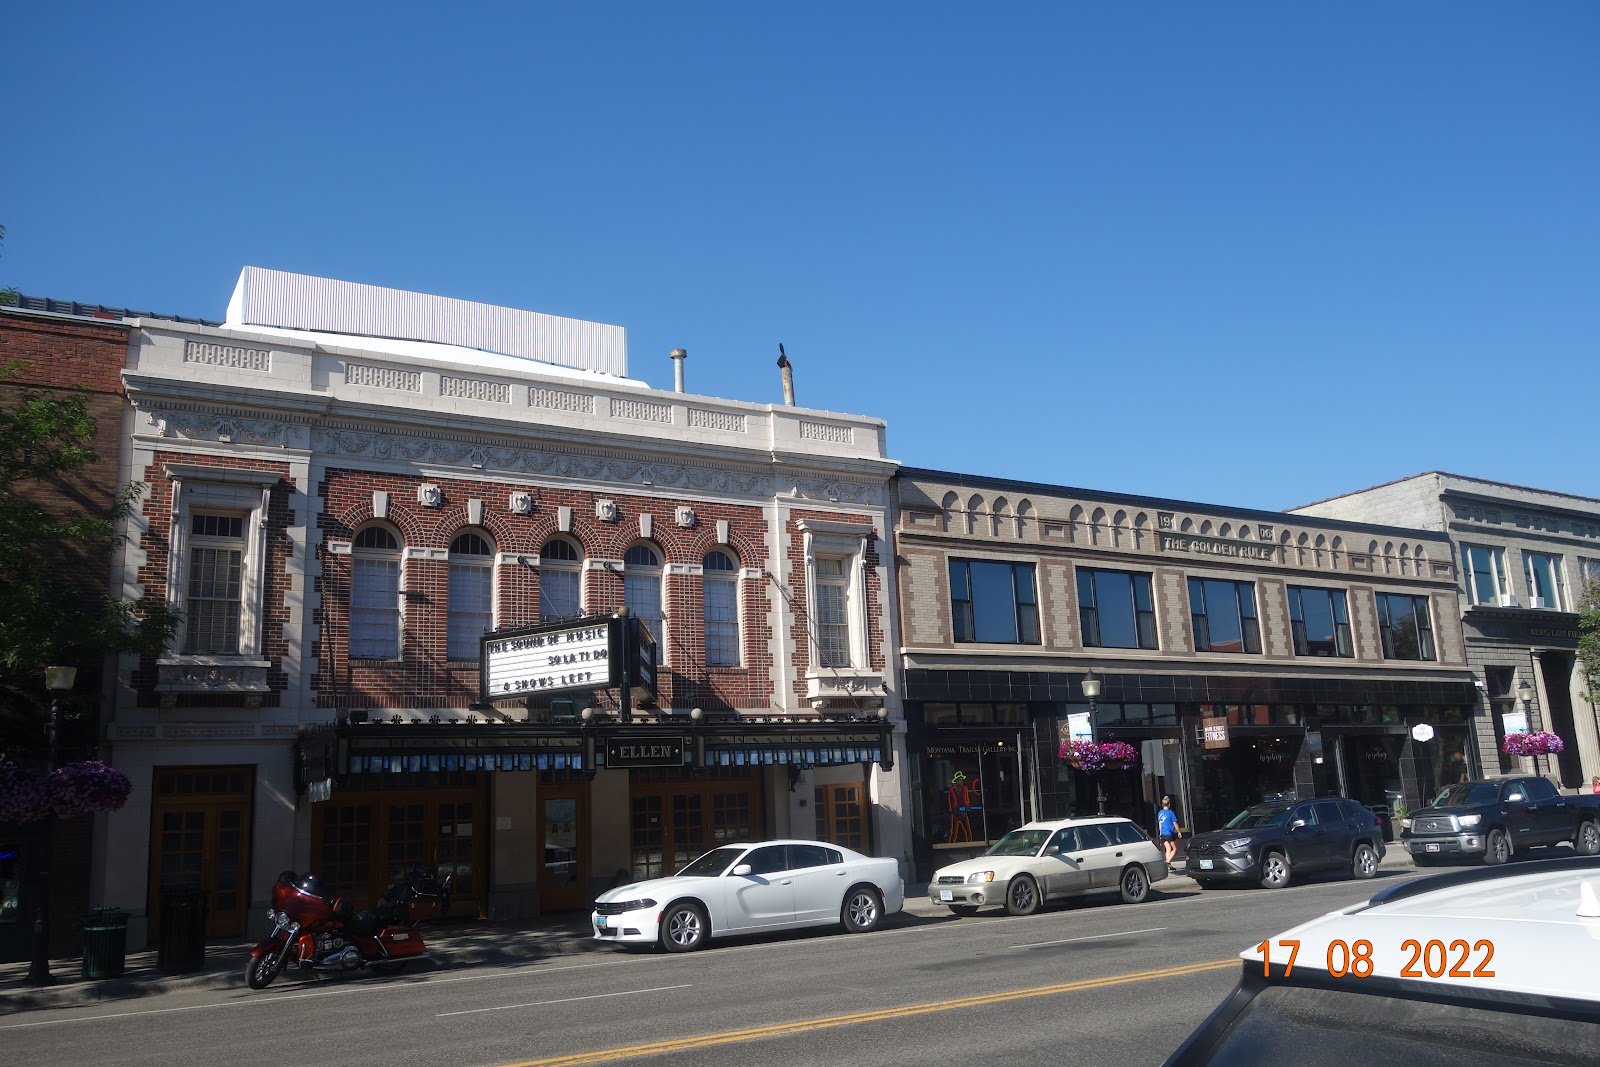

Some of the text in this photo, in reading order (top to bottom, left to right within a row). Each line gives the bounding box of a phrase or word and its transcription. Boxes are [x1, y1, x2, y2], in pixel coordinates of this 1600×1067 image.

[1165, 537, 1269, 559] THE GOLDEN RULE
[489, 628, 605, 654] THE SOUND OF MUSIC
[515, 676, 554, 690] SHOWS
[562, 672, 592, 685] LEFT
[1205, 731, 1226, 741] FITNESS
[620, 745, 671, 758] ELLEN
